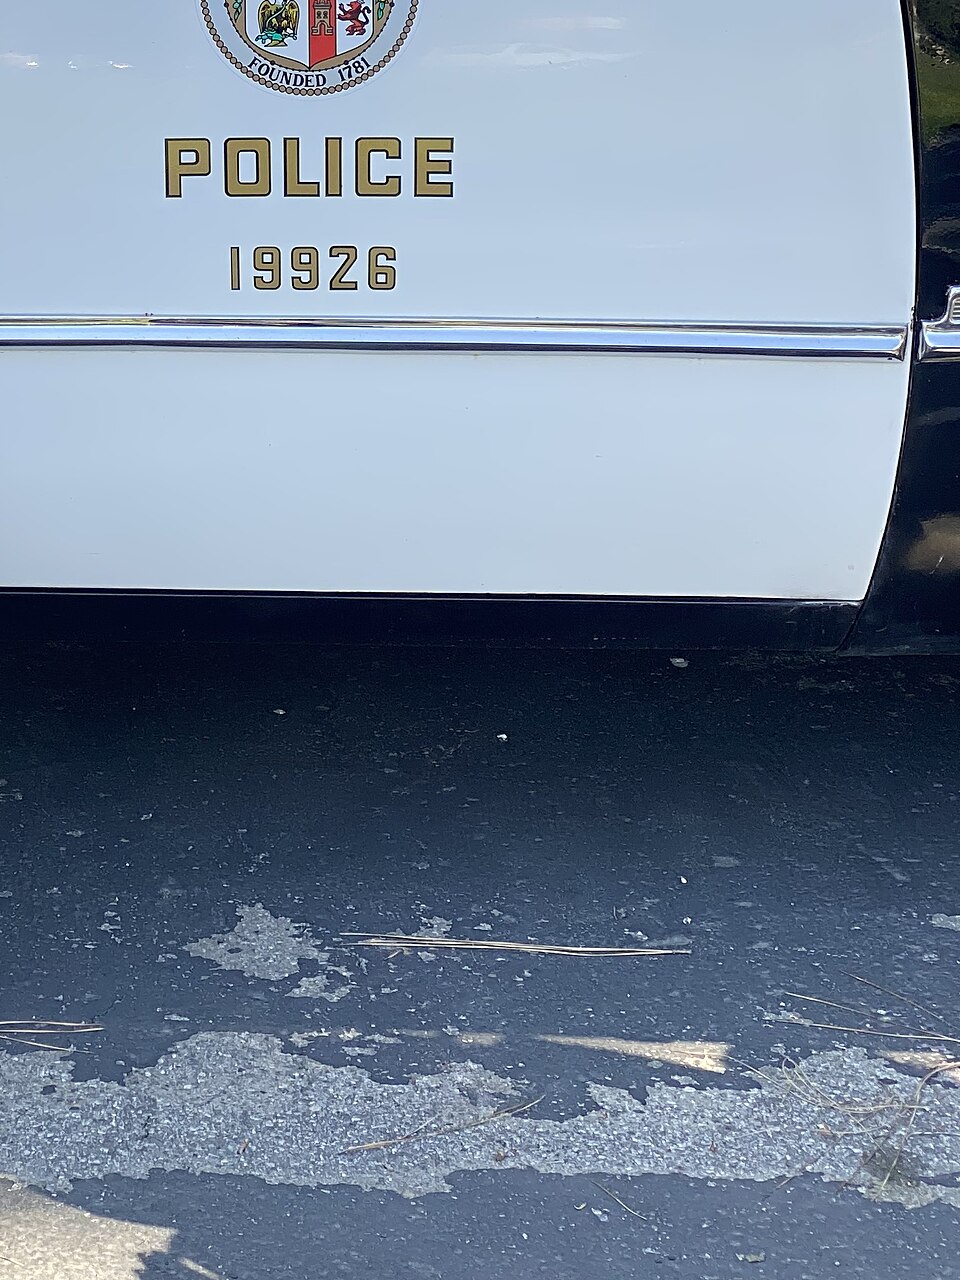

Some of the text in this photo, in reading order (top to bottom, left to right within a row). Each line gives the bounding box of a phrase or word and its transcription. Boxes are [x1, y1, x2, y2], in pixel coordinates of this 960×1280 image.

[248, 56, 372, 88] FOUNDED 1781
[164, 137, 454, 198] POLICE
[230, 245, 397, 291] 19926
